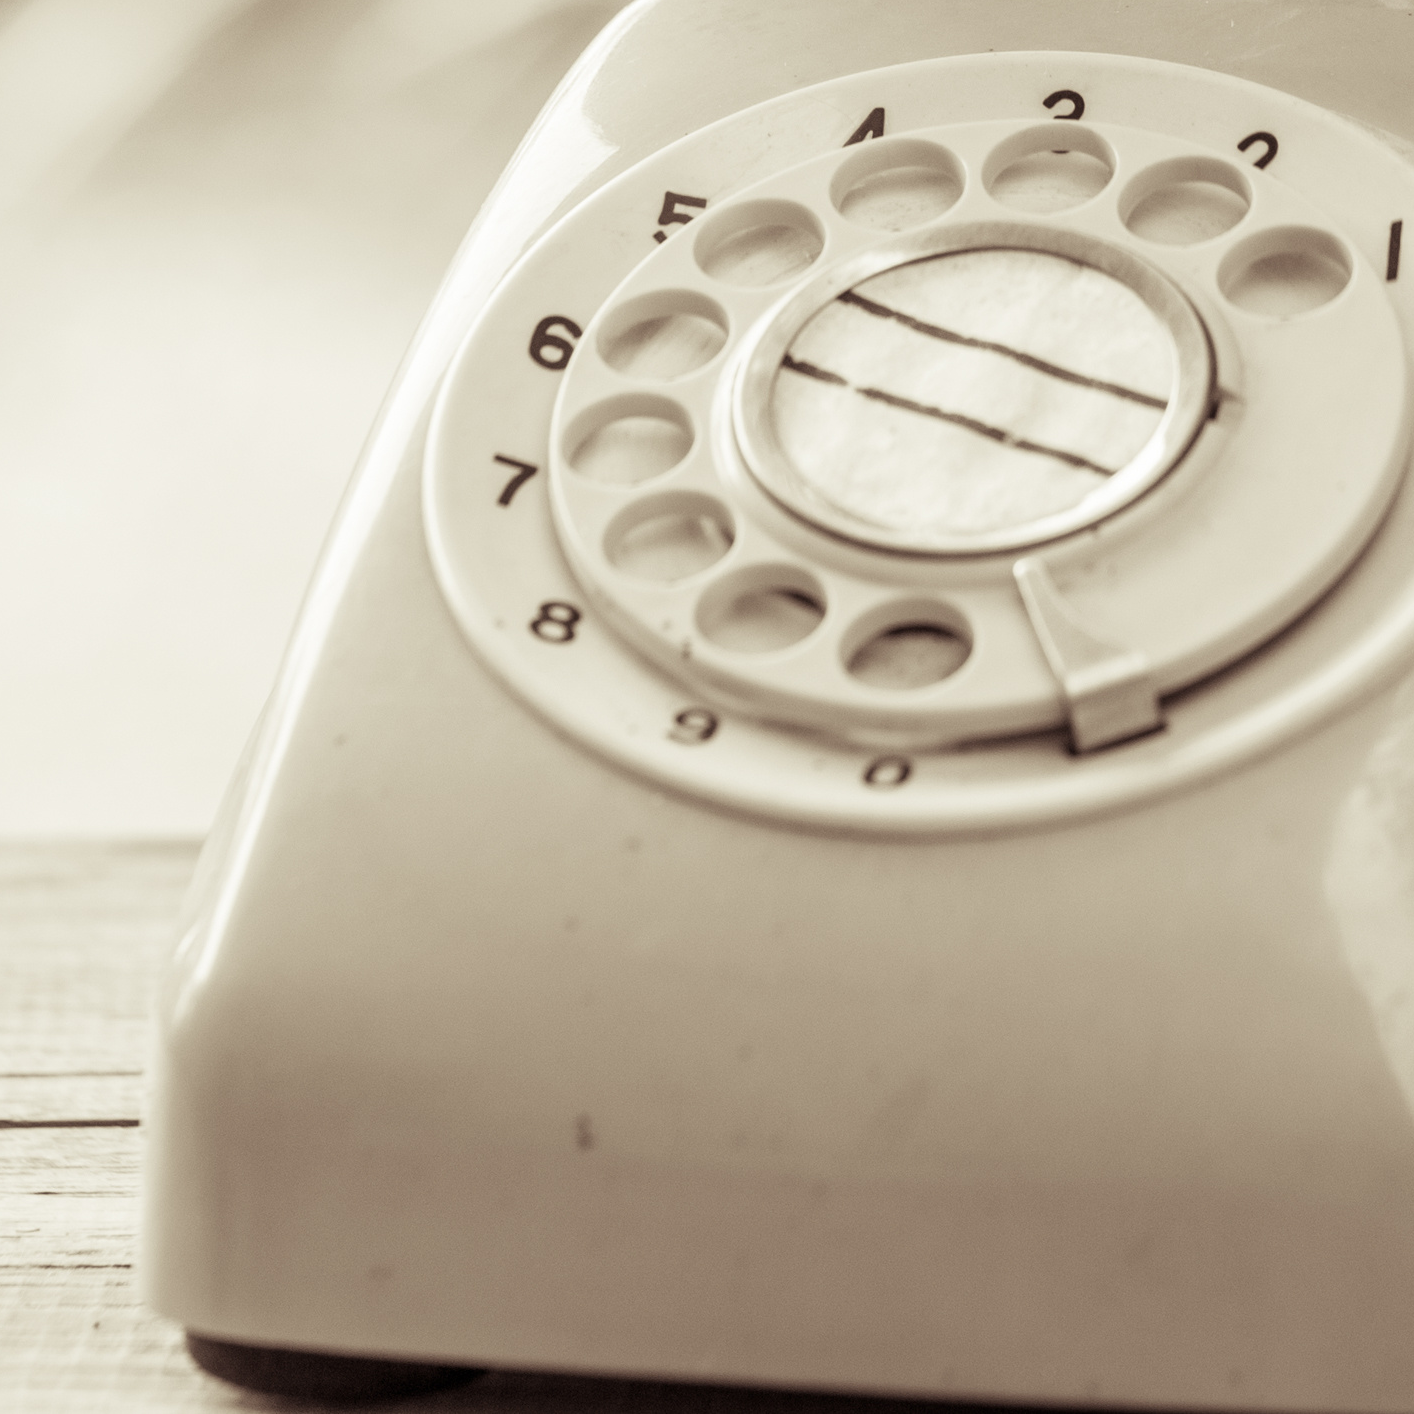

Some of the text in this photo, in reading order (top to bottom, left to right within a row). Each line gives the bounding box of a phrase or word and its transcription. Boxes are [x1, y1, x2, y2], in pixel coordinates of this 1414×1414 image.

[652, 190, 708, 244] 5
[1387, 220, 1402, 281] 1
[528, 315, 584, 371] 6
[493, 453, 538, 507] 7
[530, 601, 581, 643] 8
[668, 707, 720, 746] 9
